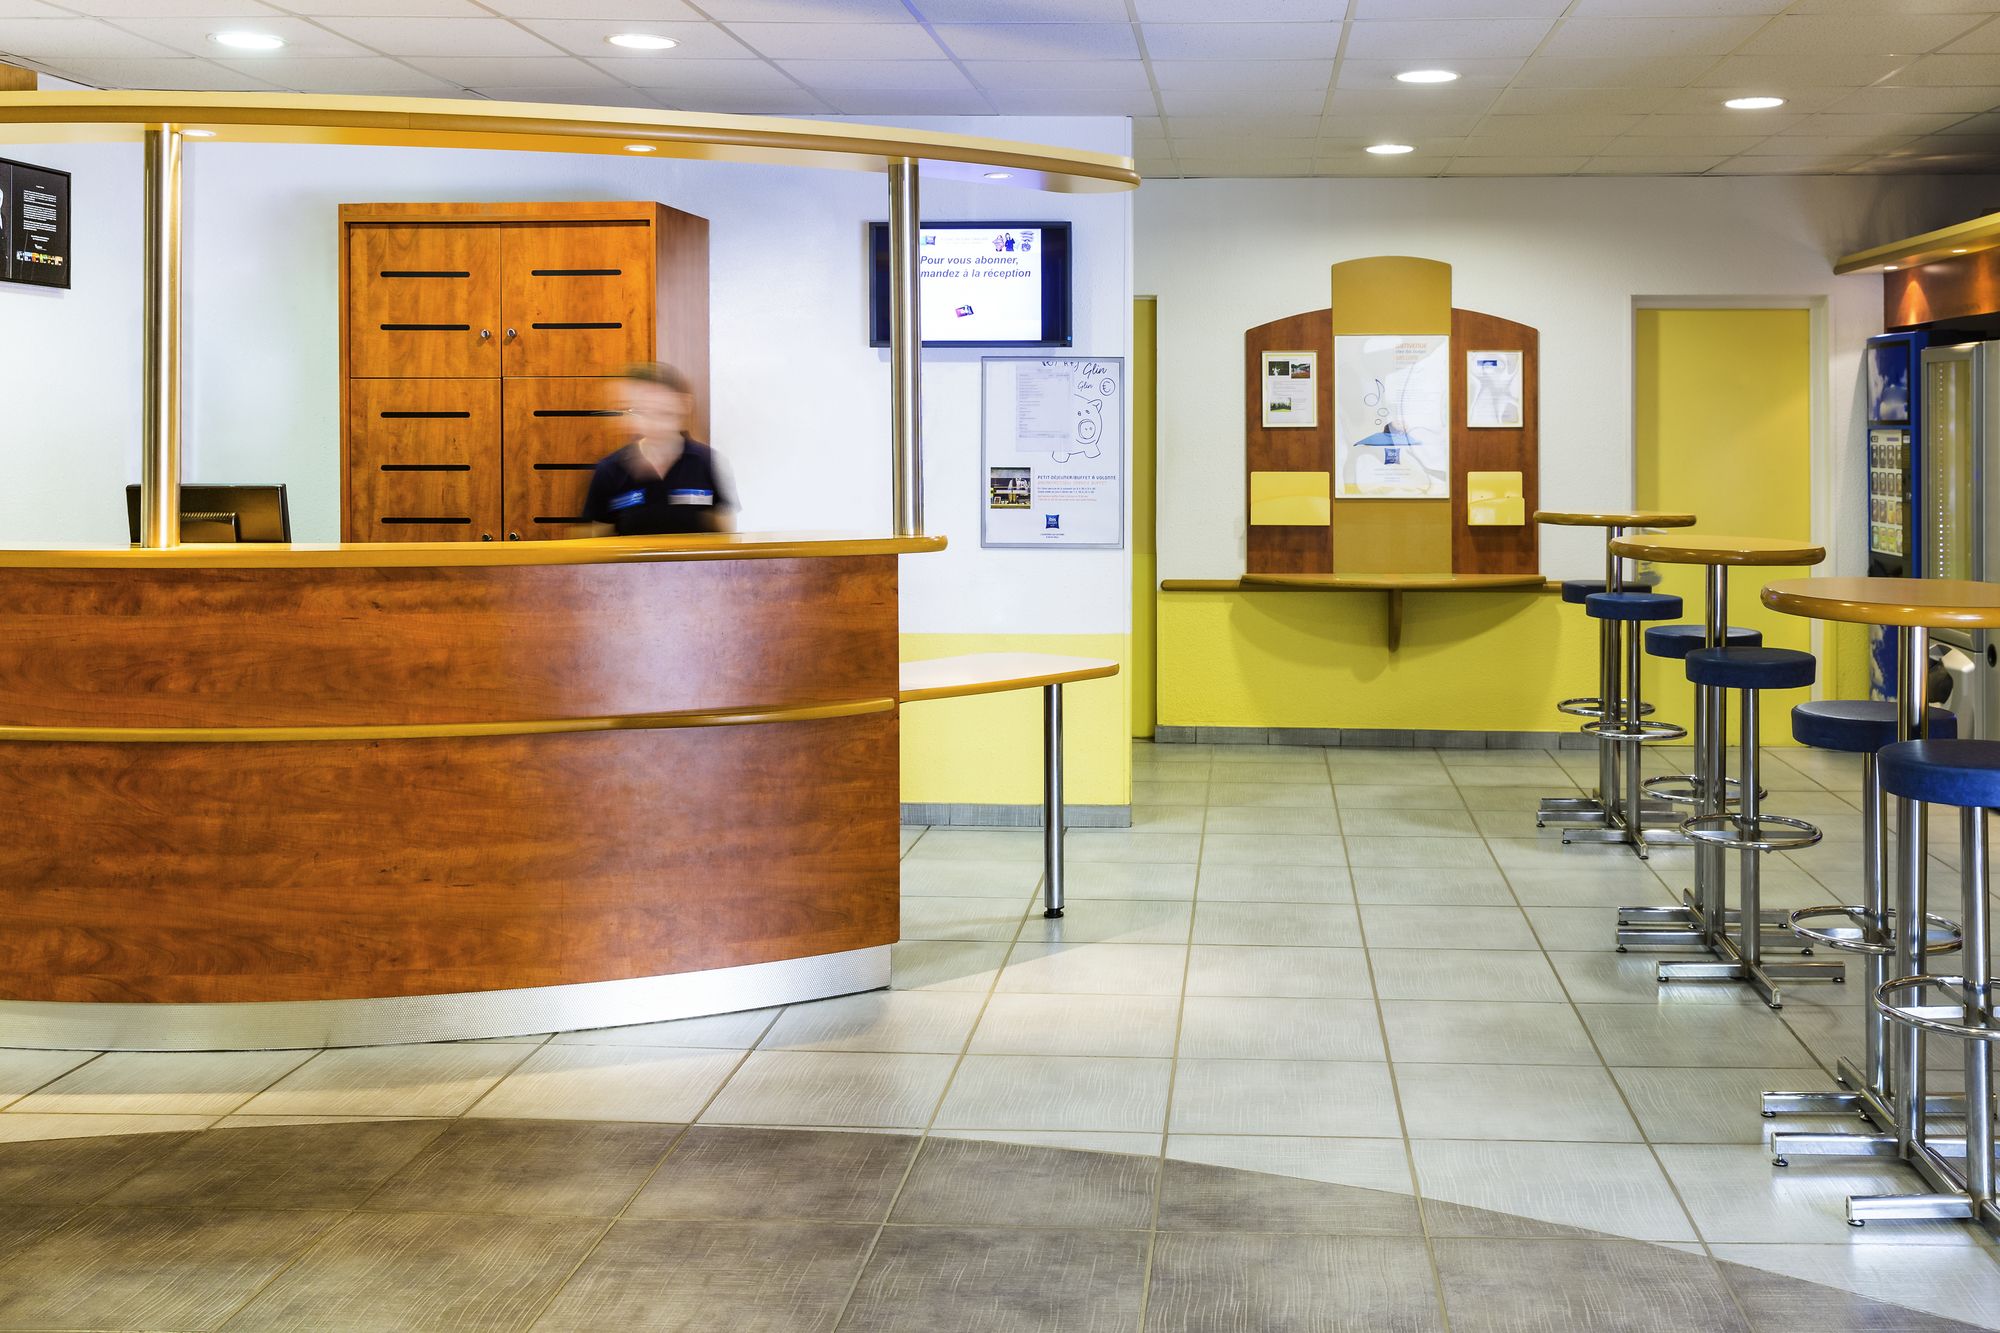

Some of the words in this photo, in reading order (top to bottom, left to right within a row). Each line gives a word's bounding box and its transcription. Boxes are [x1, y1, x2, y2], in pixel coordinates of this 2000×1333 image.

[920, 255, 944, 264] Pour
[975, 255, 1019, 265] abonner,
[963, 269, 969, 277] à
[972, 269, 980, 277] la
[983, 269, 1031, 279] réception
[1083, 362, 1107, 379] Glin
